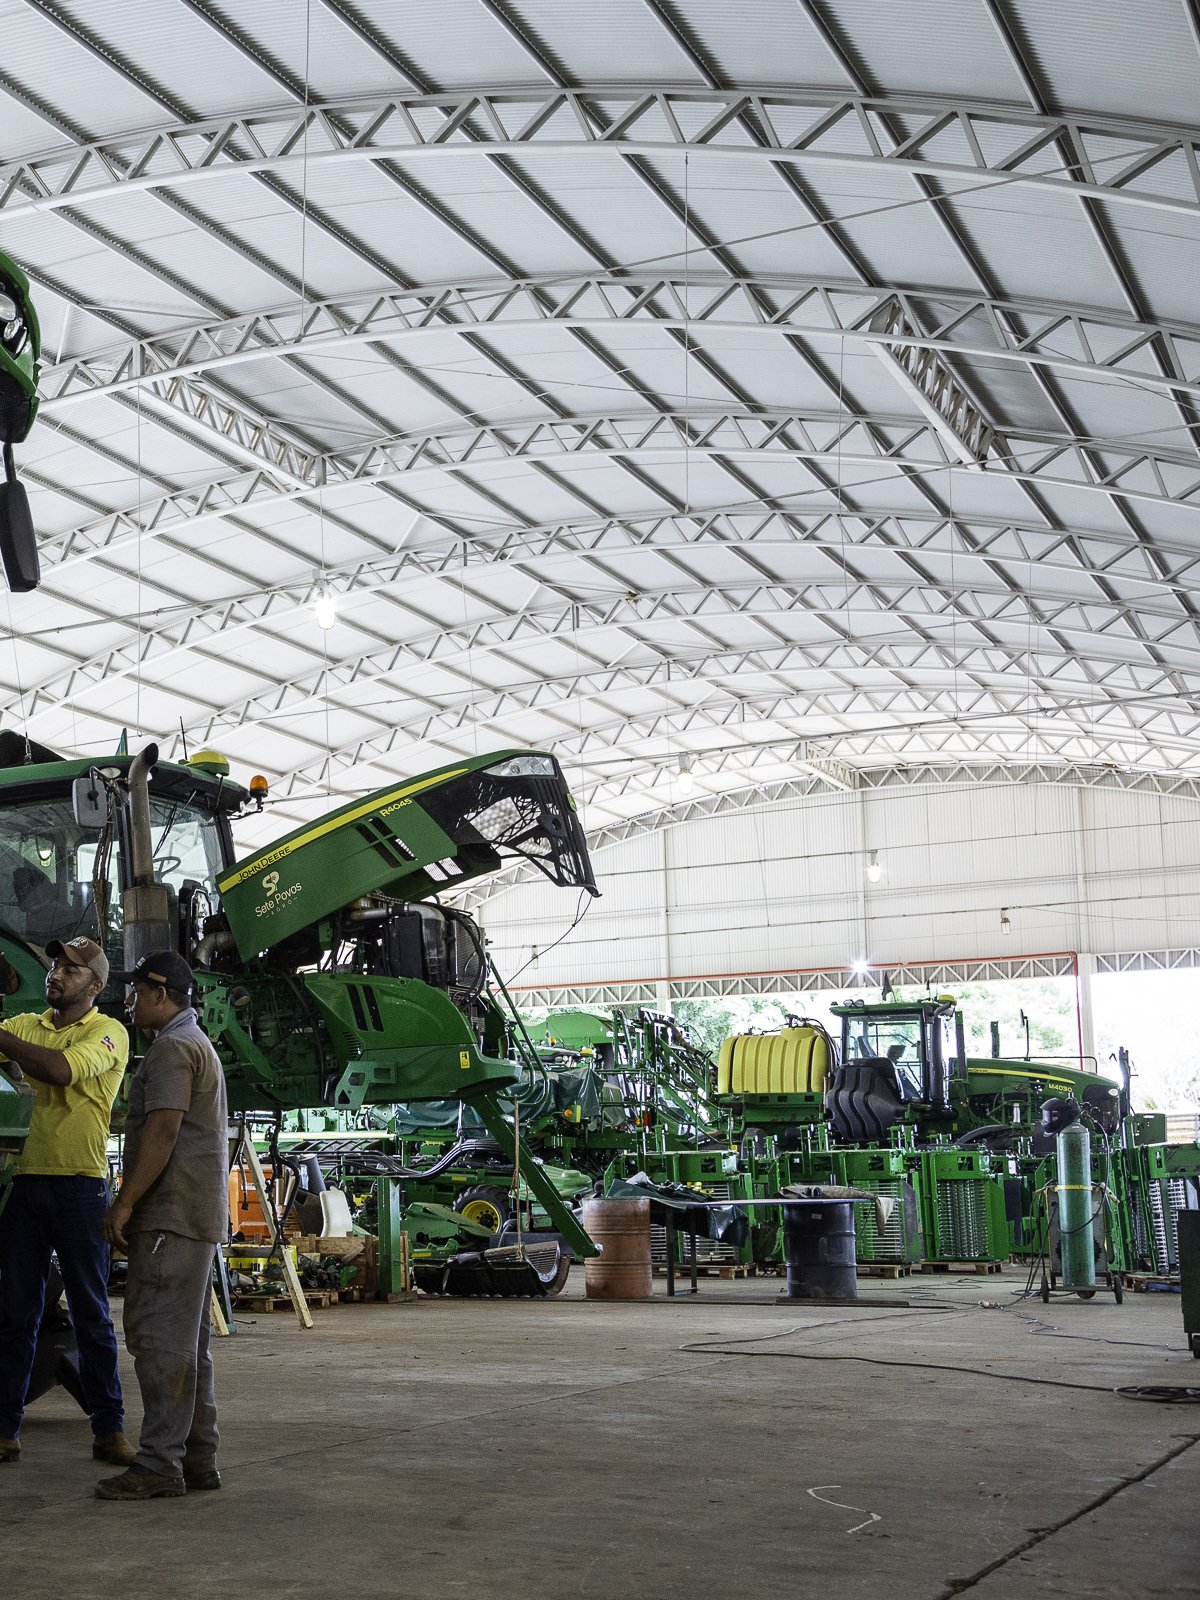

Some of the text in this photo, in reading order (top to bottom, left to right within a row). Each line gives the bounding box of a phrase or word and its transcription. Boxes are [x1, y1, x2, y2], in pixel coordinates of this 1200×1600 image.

[380, 798, 412, 816] R4045
[238, 846, 291, 884] JOHN DEERE
[255, 882, 302, 917] Sete Povos
[1048, 1083, 1072, 1093] M4030
